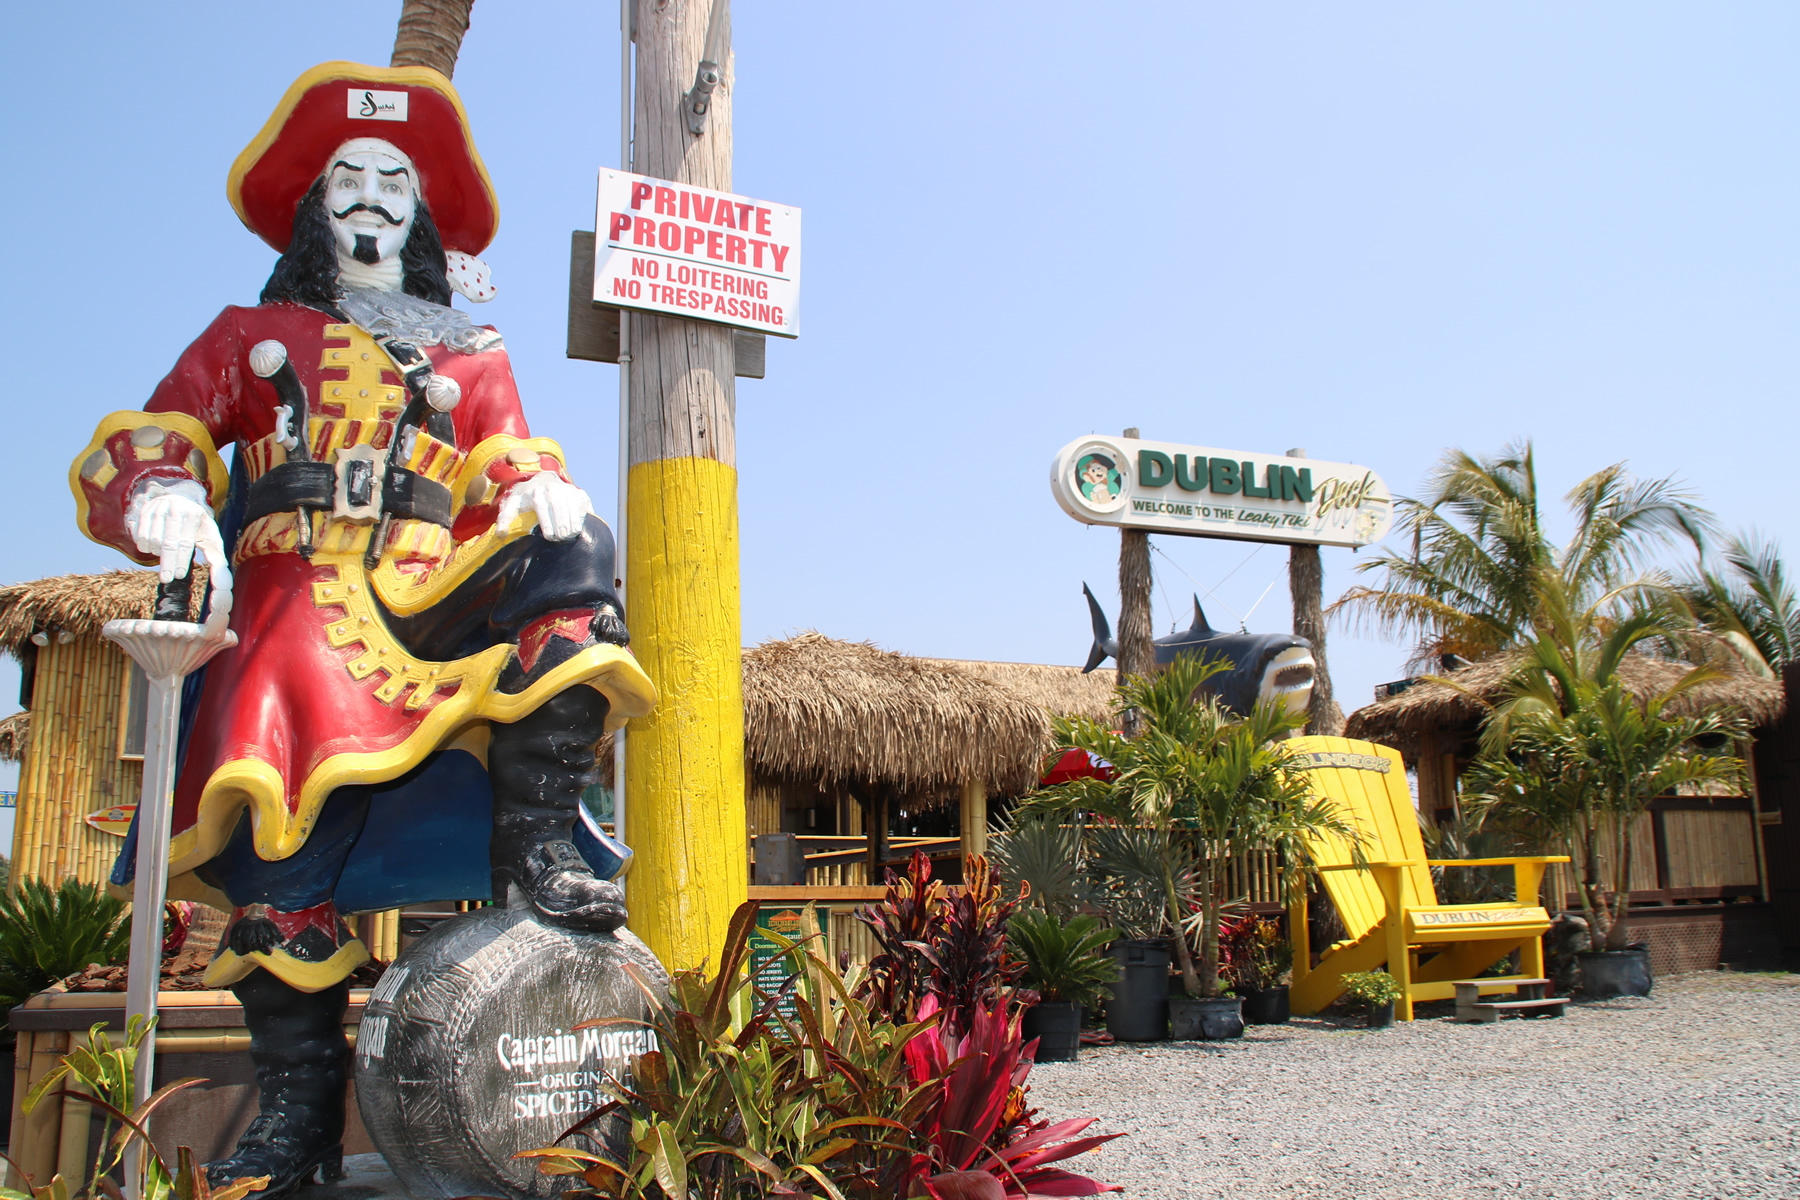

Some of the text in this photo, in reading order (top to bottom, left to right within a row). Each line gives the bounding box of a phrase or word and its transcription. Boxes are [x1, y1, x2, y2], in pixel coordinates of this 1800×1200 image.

[631, 181, 772, 237] PRIVATE
[609, 211, 790, 273] PROPERTY
[613, 277, 783, 326] NO TRESPASSING
[632, 257, 768, 301] NO LOITERING
[1138, 449, 1313, 503] DUBLIN
[1132, 500, 1311, 528] WELCOME TO THE Leaky Tiki
[1421, 911, 1491, 925] DUBLIN
[497, 1028, 660, 1074] Captain Morgan
[514, 1089, 594, 1120] SPICED
